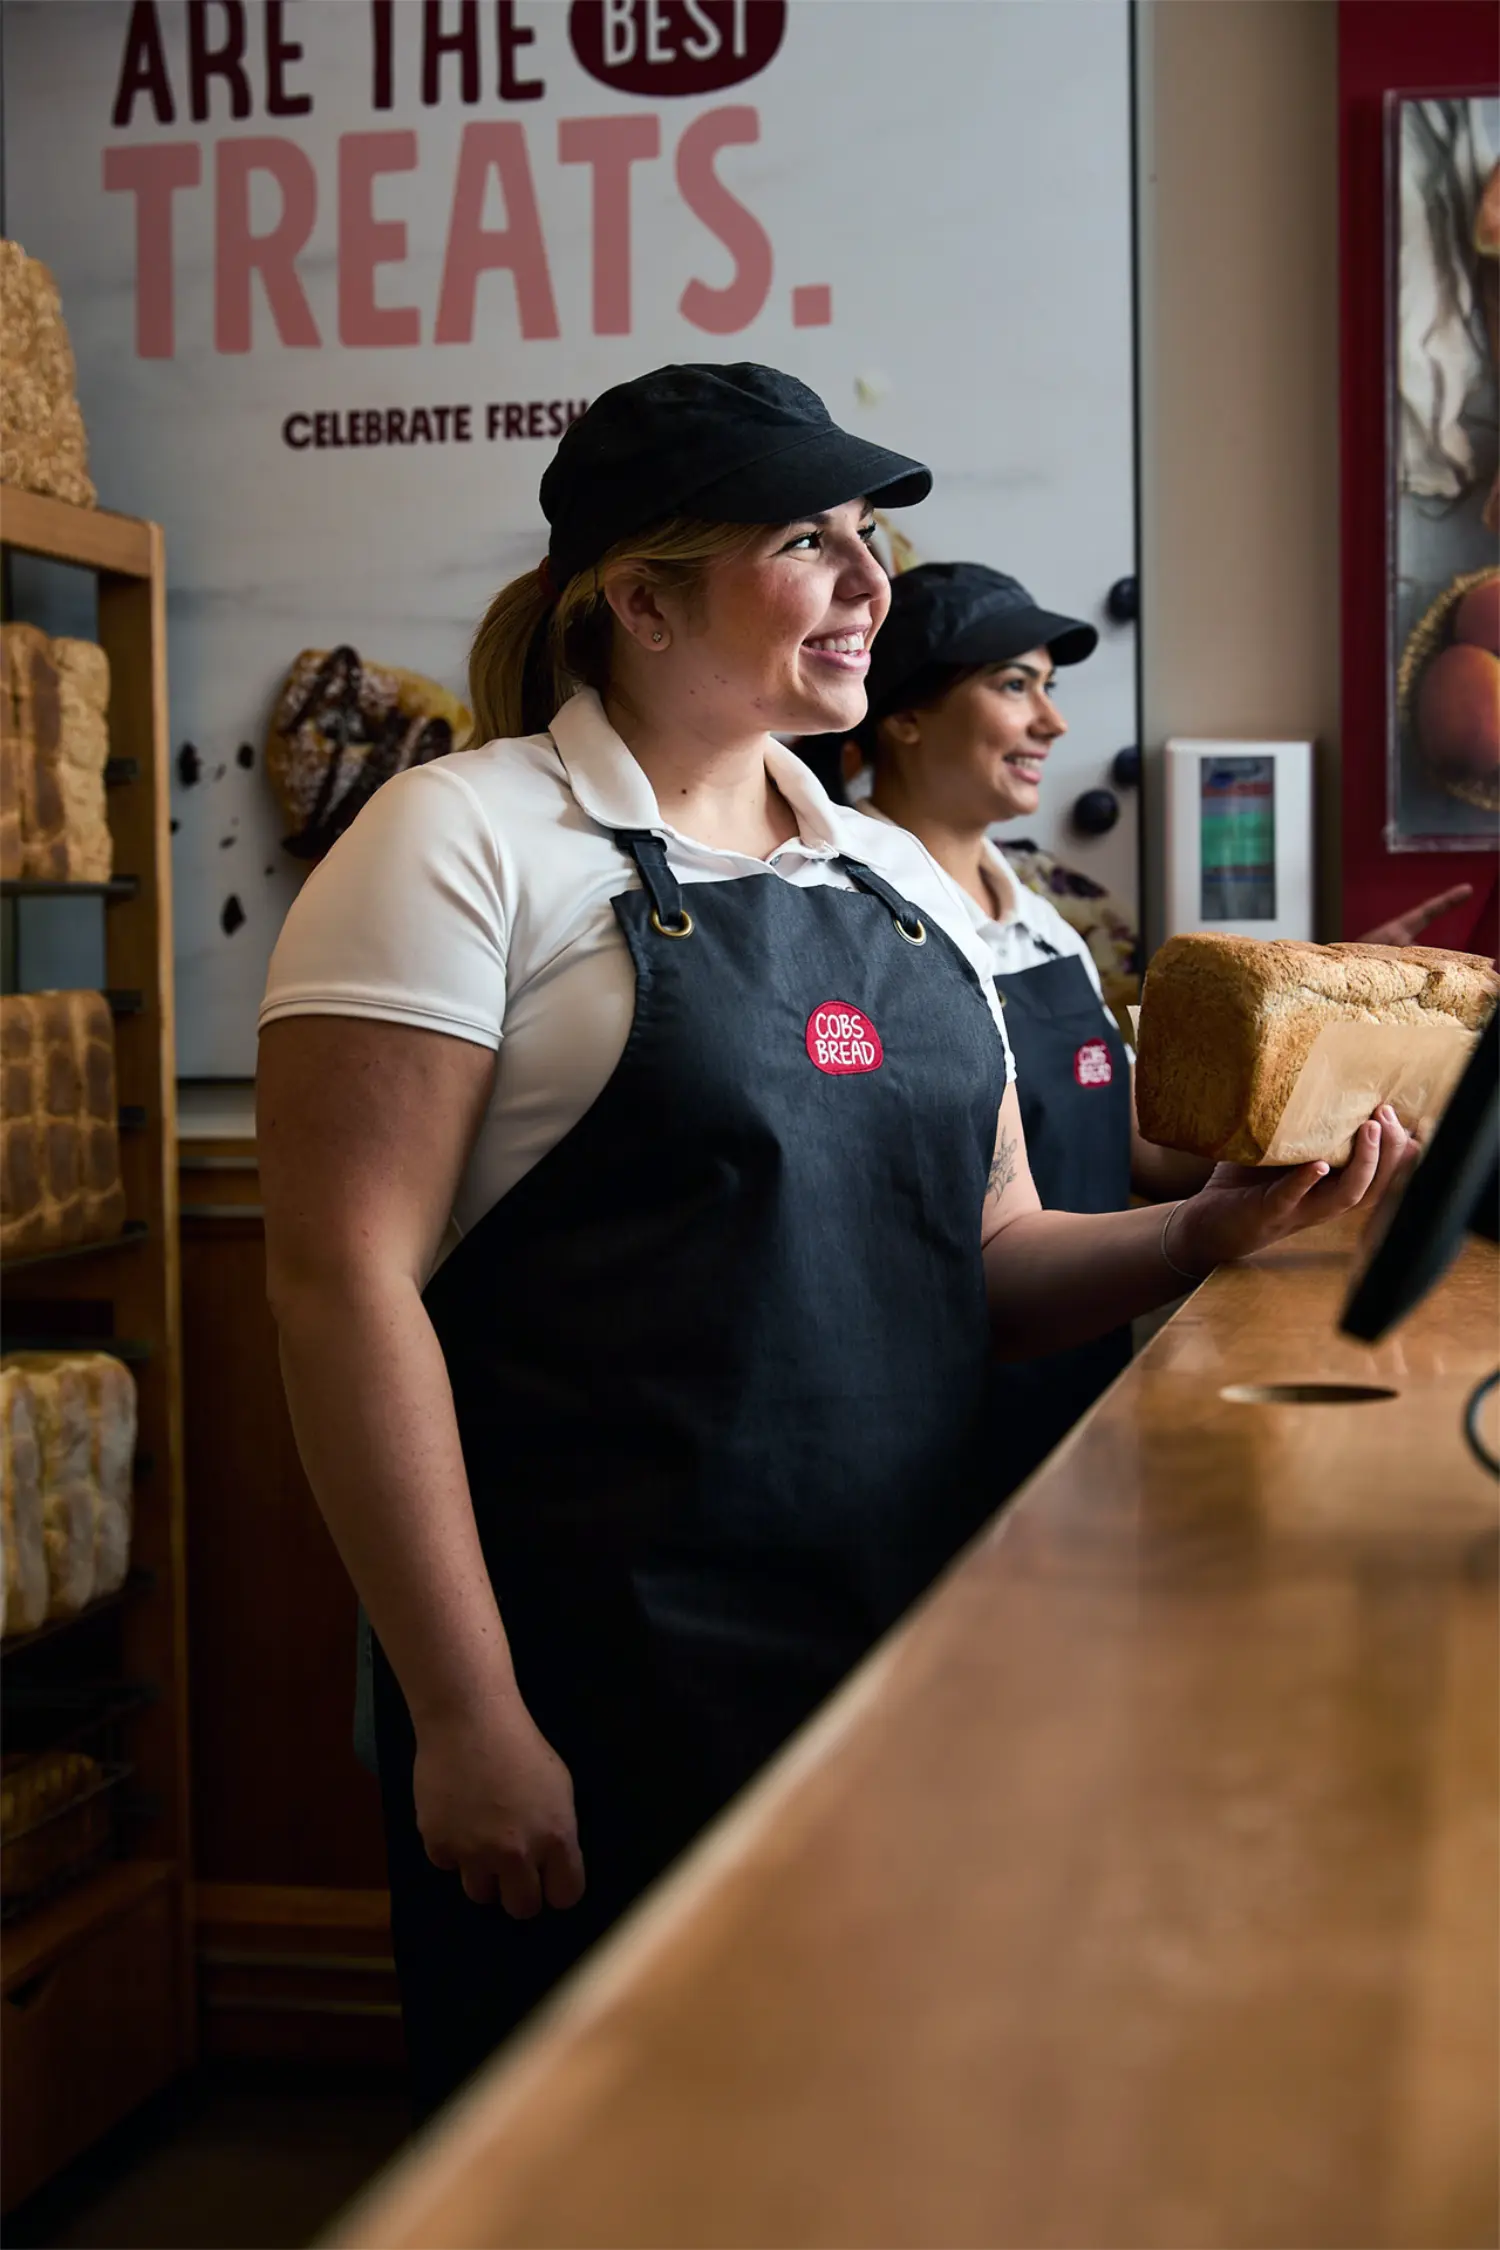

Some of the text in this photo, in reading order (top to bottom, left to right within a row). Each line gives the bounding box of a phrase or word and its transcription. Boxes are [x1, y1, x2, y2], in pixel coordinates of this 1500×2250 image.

[111, 0, 313, 128] ARE
[372, 0, 546, 111] THE
[102, 105, 833, 360] TREATS.
[282, 404, 472, 451] CELEBRATE
[815, 1012, 865, 1039] COBS
[814, 1039, 875, 1066] BREAD
